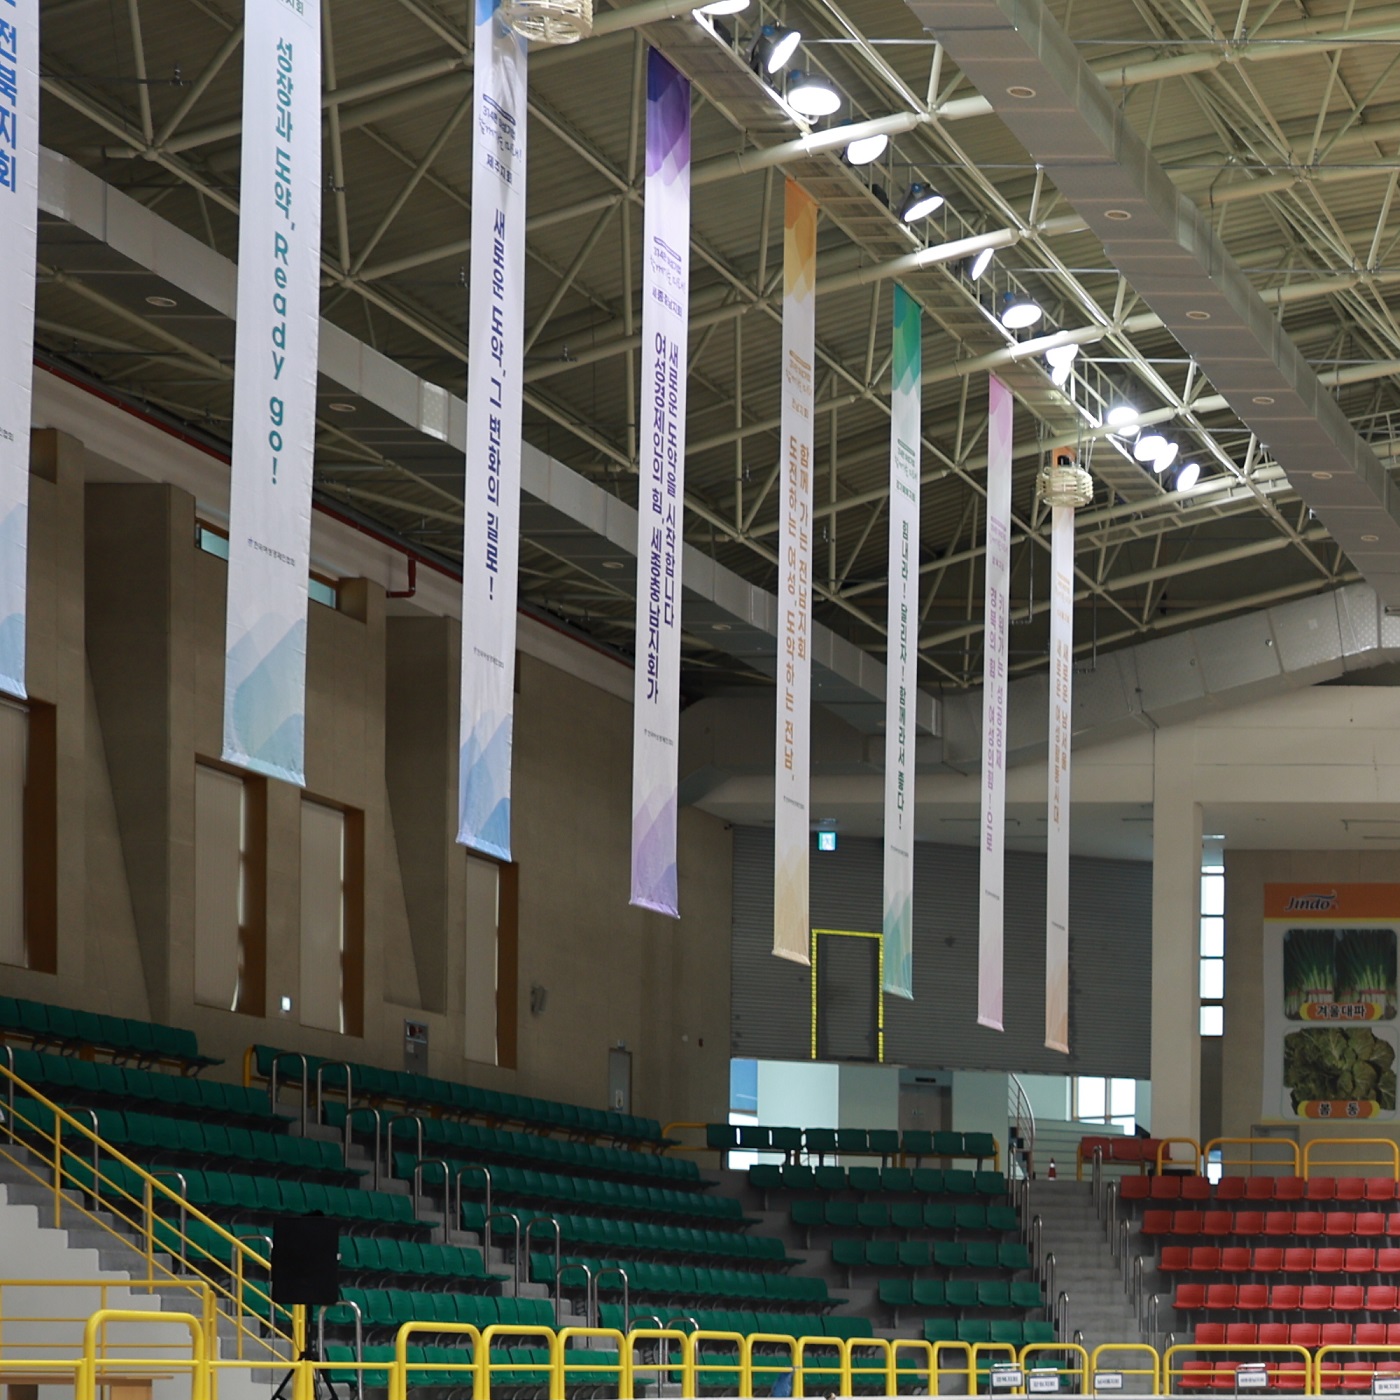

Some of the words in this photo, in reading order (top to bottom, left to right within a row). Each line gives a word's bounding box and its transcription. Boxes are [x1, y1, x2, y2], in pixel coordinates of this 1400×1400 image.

[276, 37, 293, 142] 성장과
[275, 146, 296, 231] 도약,
[493, 208, 505, 300] 새로운
[271, 231, 290, 381] Ready
[491, 305, 506, 377] 도약,
[490, 377, 502, 408] 그
[652, 332, 666, 484] 여성경제인의
[667, 340, 679, 418] 새로운
[269, 396, 284, 485] go!
[487, 416, 502, 507] 변화의
[666, 421, 677, 498] 도약을
[799, 444, 809, 495] 함께
[652, 487, 664, 524] 힘,
[788, 435, 797, 537] 도전하는
[799, 501, 809, 552] 가는
[485, 510, 501, 601] 길로!
[664, 503, 676, 628] 시작합니다
[787, 546, 797, 607] 여성,
[647, 526, 661, 704] 세종충남지회가
[797, 559, 808, 661] 전남지회
[785, 610, 796, 712] 도약하는
[784, 720, 795, 781] 전남,
[897, 771, 905, 830] 좋다!
[1316, 1004, 1366, 1018] 겨울대파
